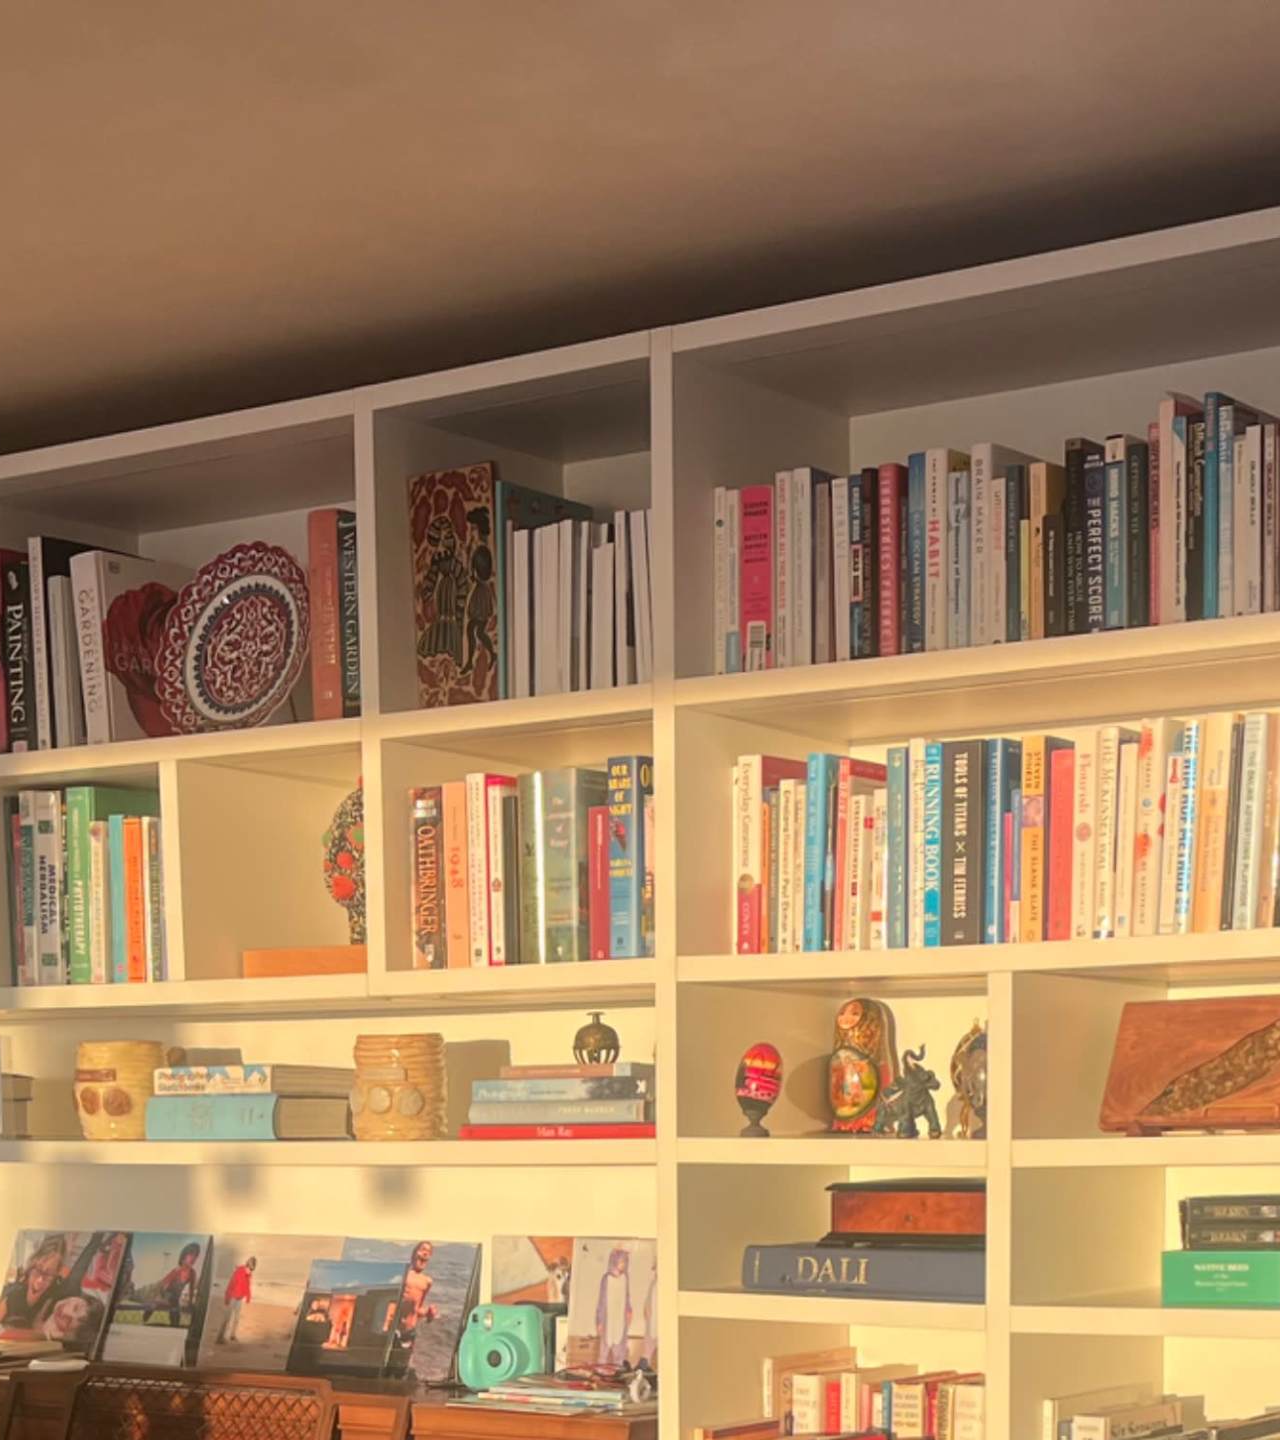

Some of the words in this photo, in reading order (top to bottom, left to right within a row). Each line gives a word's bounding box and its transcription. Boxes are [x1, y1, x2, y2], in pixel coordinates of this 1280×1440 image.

[975, 458, 984, 500] BRAIN
[1110, 468, 1119, 498] MIND
[975, 506, 984, 554] MAKER
[1088, 509, 1102, 572] PERFECT
[1109, 500, 1119, 538] HACKS
[929, 520, 940, 579] HABIT
[343, 532, 358, 616] WESTERN
[912, 576, 920, 624] STRATEGY
[1088, 576, 1102, 622] SCORE
[6, 604, 25, 722] PAINTING
[78, 590, 98, 713] GARDENING
[346, 620, 360, 695] GARDEN
[1184, 726, 1200, 754] THE
[740, 762, 752, 812] Everyday
[954, 753, 968, 784] TOOLS
[1079, 753, 1091, 814] Flourish
[782, 790, 790, 832] Emotions
[839, 781, 848, 820] DRIVE
[925, 763, 940, 839] RUNNING
[954, 786, 968, 799] OF
[954, 802, 968, 836] TITANS
[1242, 804, 1254, 860] ADVERTISING
[417, 826, 440, 934] OATHBRINGER
[782, 878, 790, 899] Paul
[925, 844, 939, 891] BOOK
[954, 856, 967, 876] TIM
[40, 855, 48, 934] HERBALISM
[48, 864, 58, 925] MEDICAL
[73, 880, 86, 955] PHYTOTHERAPY
[782, 901, 790, 933] Ekman
[953, 878, 966, 918] FERRISS
[1030, 894, 1038, 921] SLATE
[796, 1256, 868, 1285] DALI
